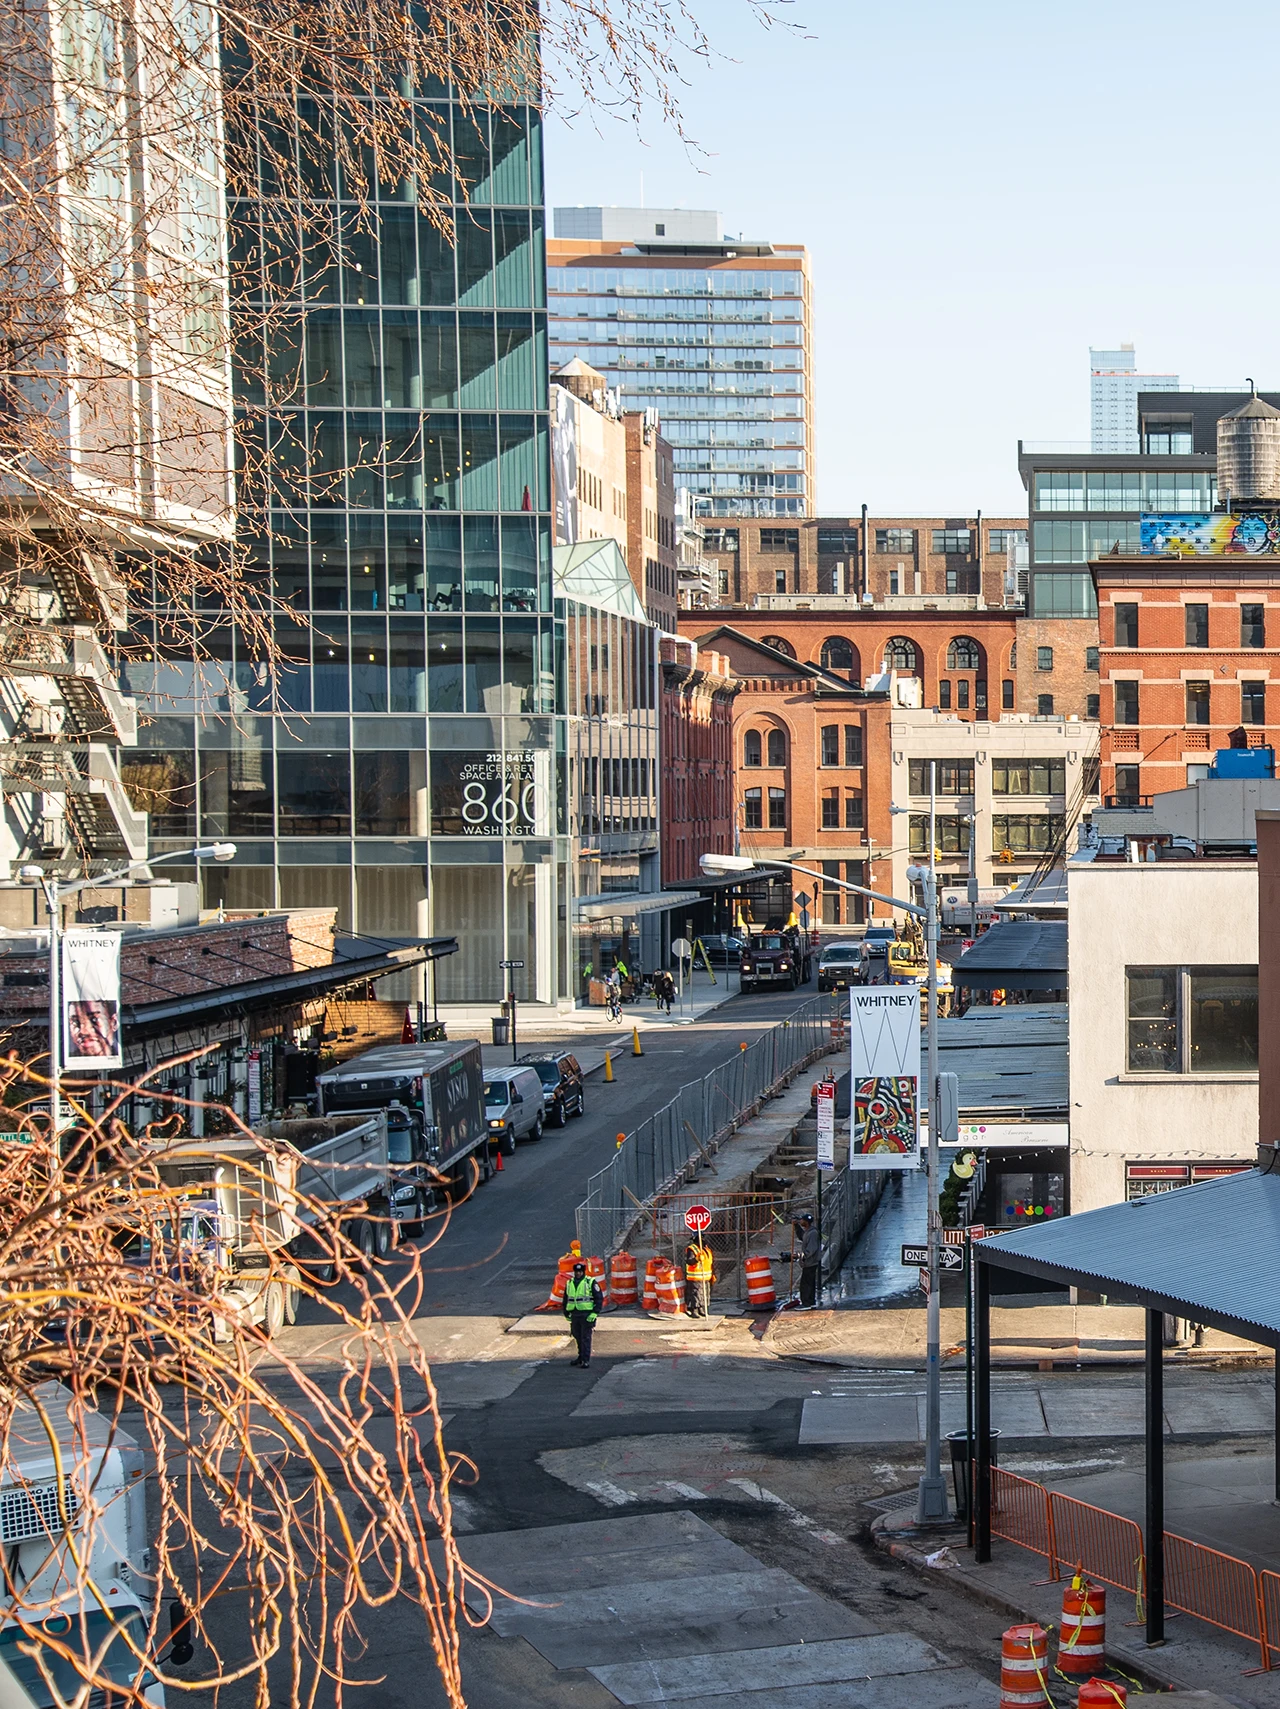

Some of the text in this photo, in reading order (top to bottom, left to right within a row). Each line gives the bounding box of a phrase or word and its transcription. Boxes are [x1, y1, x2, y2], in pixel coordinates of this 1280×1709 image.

[464, 764, 501, 772] OFFICE
[514, 764, 534, 772] RET
[460, 772, 535, 780] SPACE AVAILA
[462, 782, 549, 823] 860
[463, 826, 537, 835] WASHINGT
[857, 995, 914, 1007] WHITNEY
[686, 1212, 710, 1224] STOP
[944, 1231, 966, 1244] LITTL
[906, 1250, 927, 1261] ONE
[2, 1483, 73, 1500] THERMO KIG
